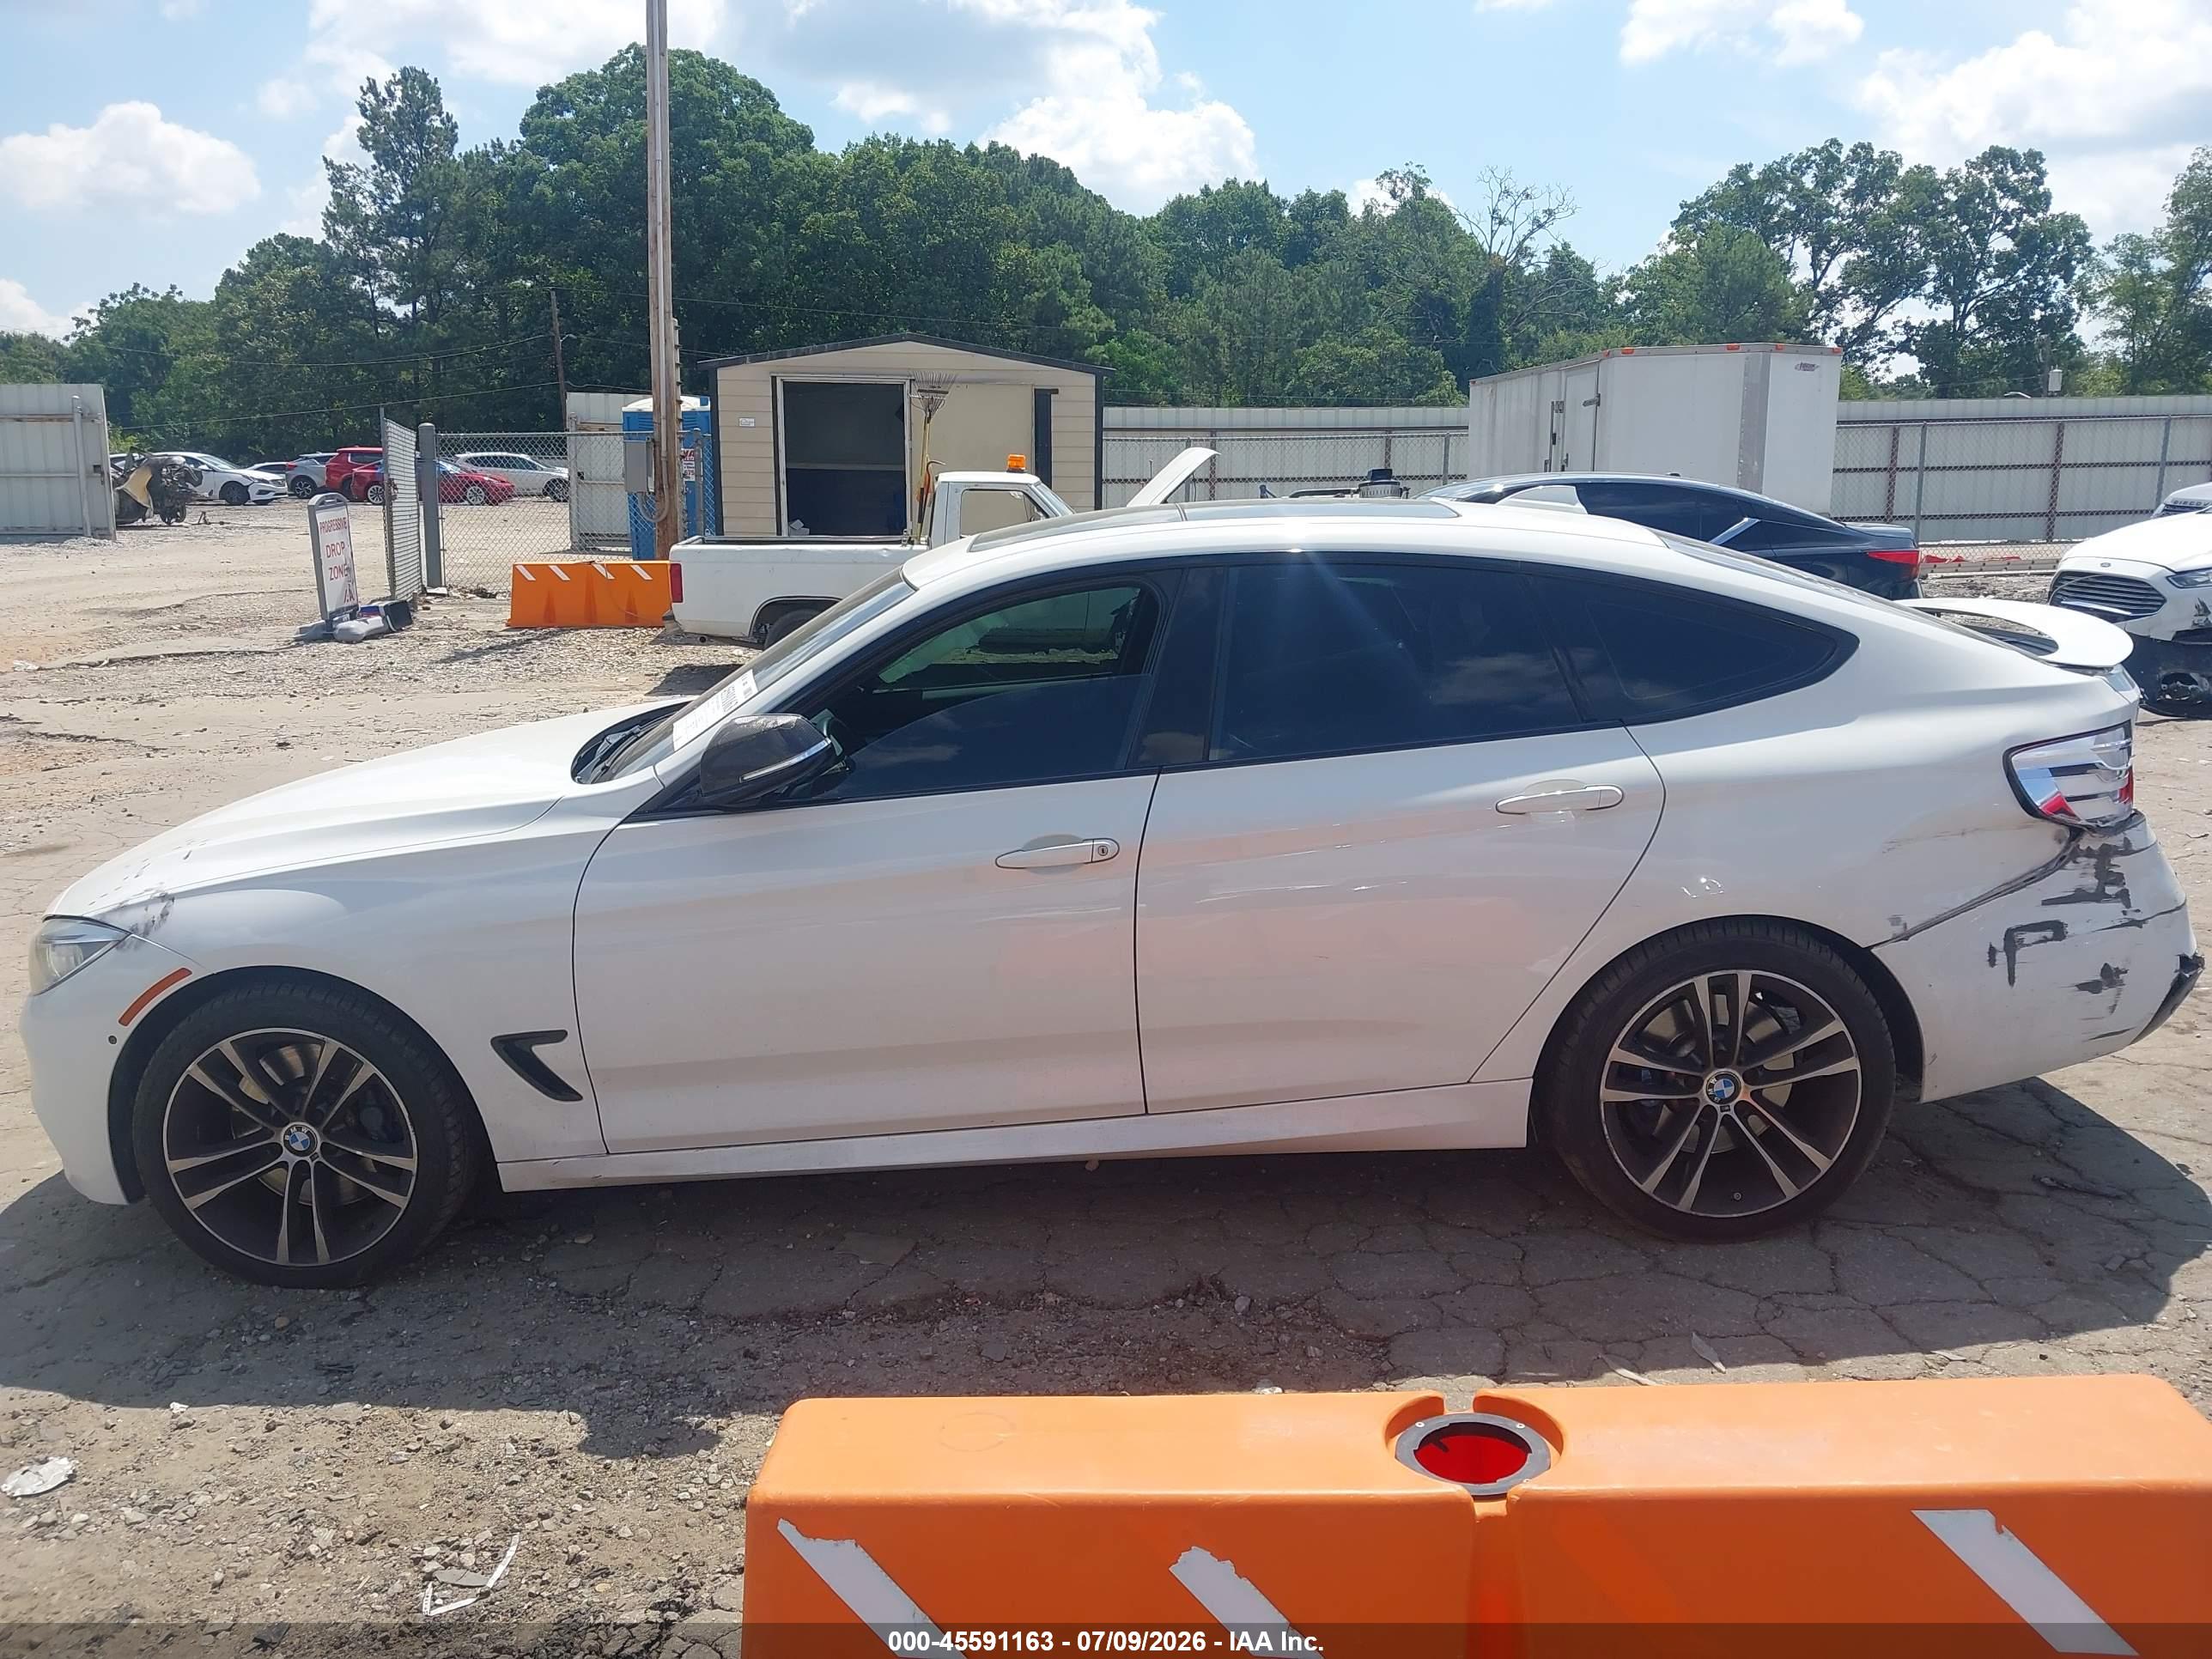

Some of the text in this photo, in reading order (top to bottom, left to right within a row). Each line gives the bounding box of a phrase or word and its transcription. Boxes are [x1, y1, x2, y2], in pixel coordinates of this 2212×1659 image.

[319, 517, 347, 534] PROGRESSIVE
[325, 541, 345, 558] DROP
[329, 563, 349, 580] ZONE
